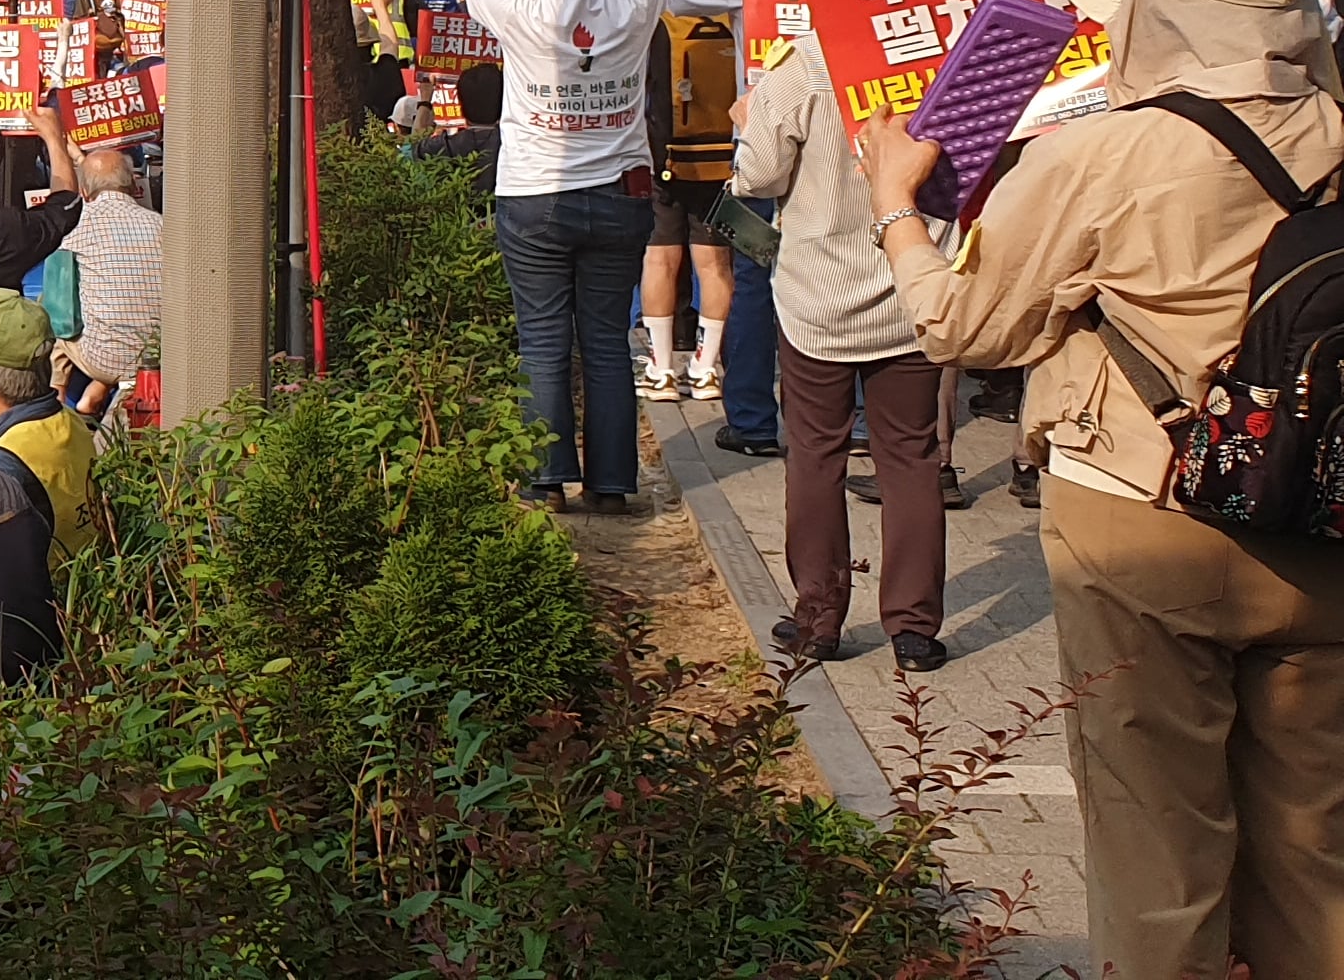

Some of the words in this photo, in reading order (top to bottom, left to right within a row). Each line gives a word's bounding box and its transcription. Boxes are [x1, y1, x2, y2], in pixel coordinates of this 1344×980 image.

[71, 76, 142, 105] 투표항쟁
[527, 83, 552, 97] 바른
[556, 83, 587, 97] 언론,
[590, 80, 616, 94] 바른
[620, 73, 639, 89] 세상
[591, 94, 628, 111] 나서서
[529, 112, 602, 132] 조선일보
